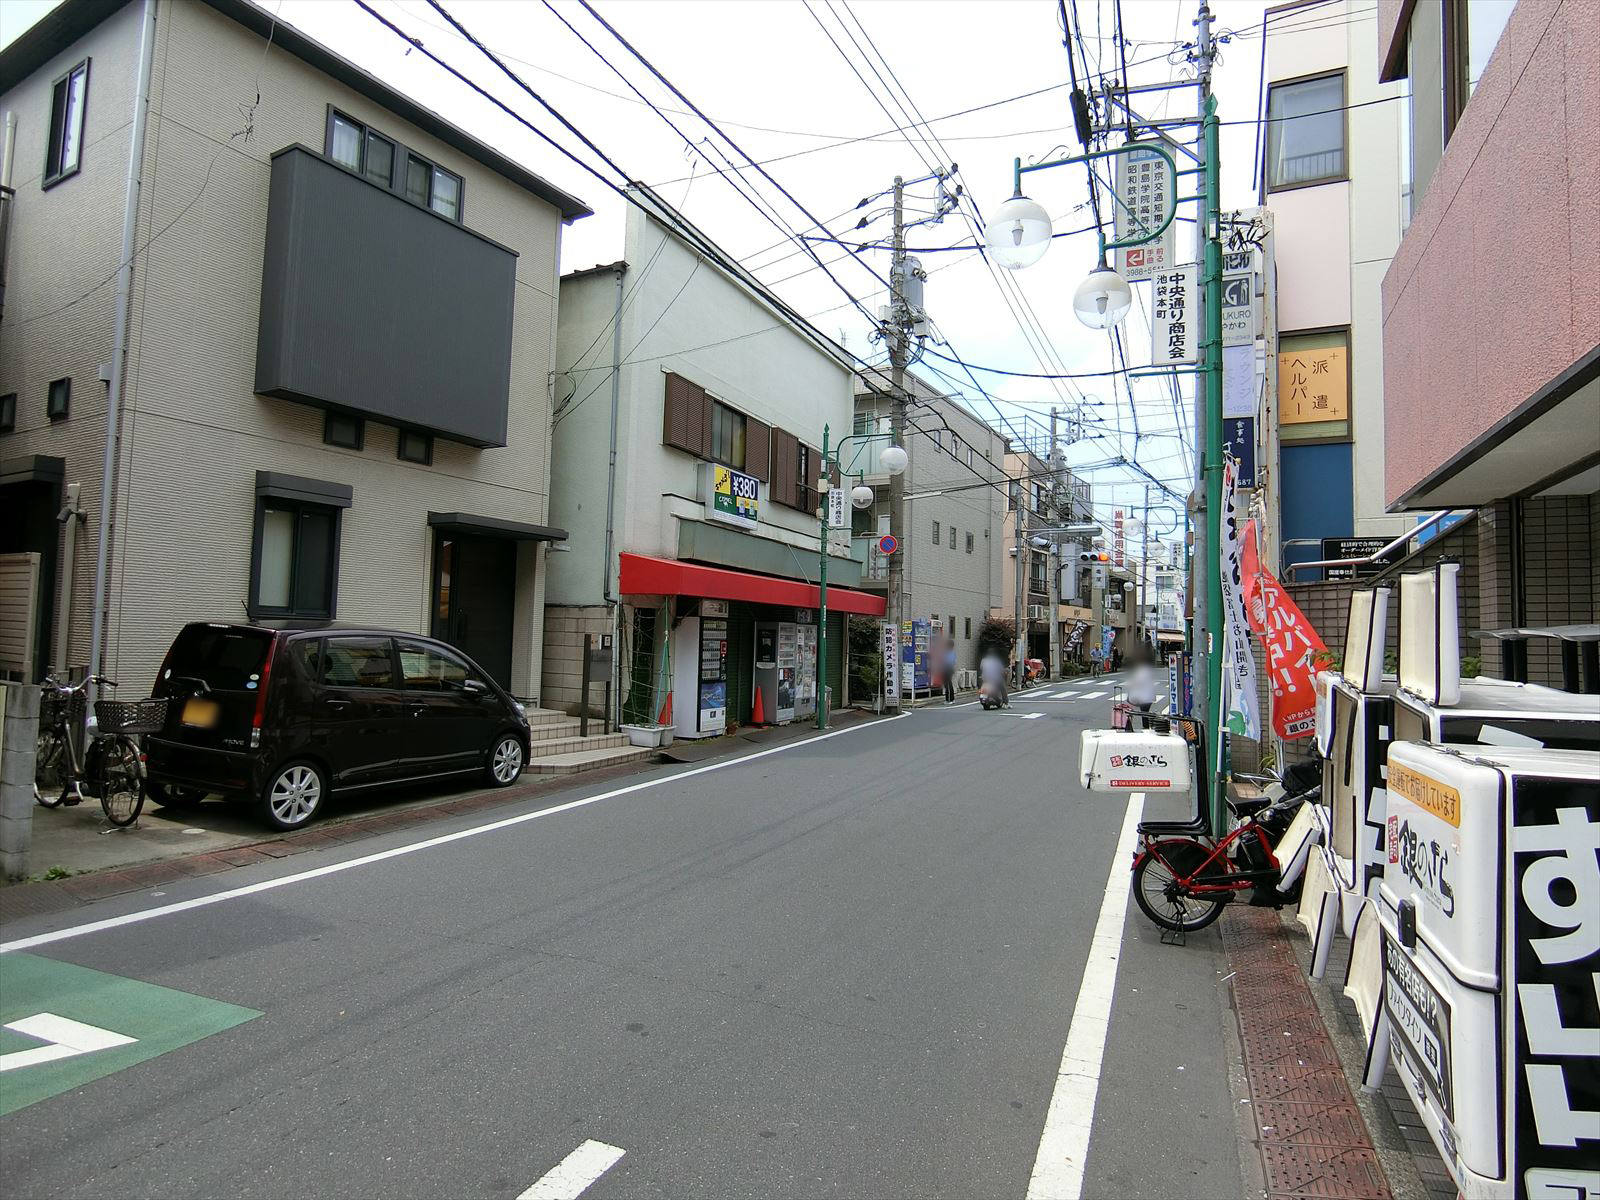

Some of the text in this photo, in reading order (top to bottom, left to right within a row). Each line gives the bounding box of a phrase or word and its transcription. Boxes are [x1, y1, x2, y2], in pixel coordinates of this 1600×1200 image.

[1127, 165, 1138, 241] 昭和鉄道高等学
[1140, 163, 1150, 246] 豊島学院高等
[1156, 274, 1168, 319] 池袋本町
[1169, 272, 1185, 359] 中央通り商店会
[1290, 358, 1308, 416] ヘルパー
[1312, 359, 1329, 410] 派遣
[733, 475, 756, 499] ¥380
[1123, 754, 1168, 768] 銀のさら
[1398, 819, 1455, 919] 銀のさら
